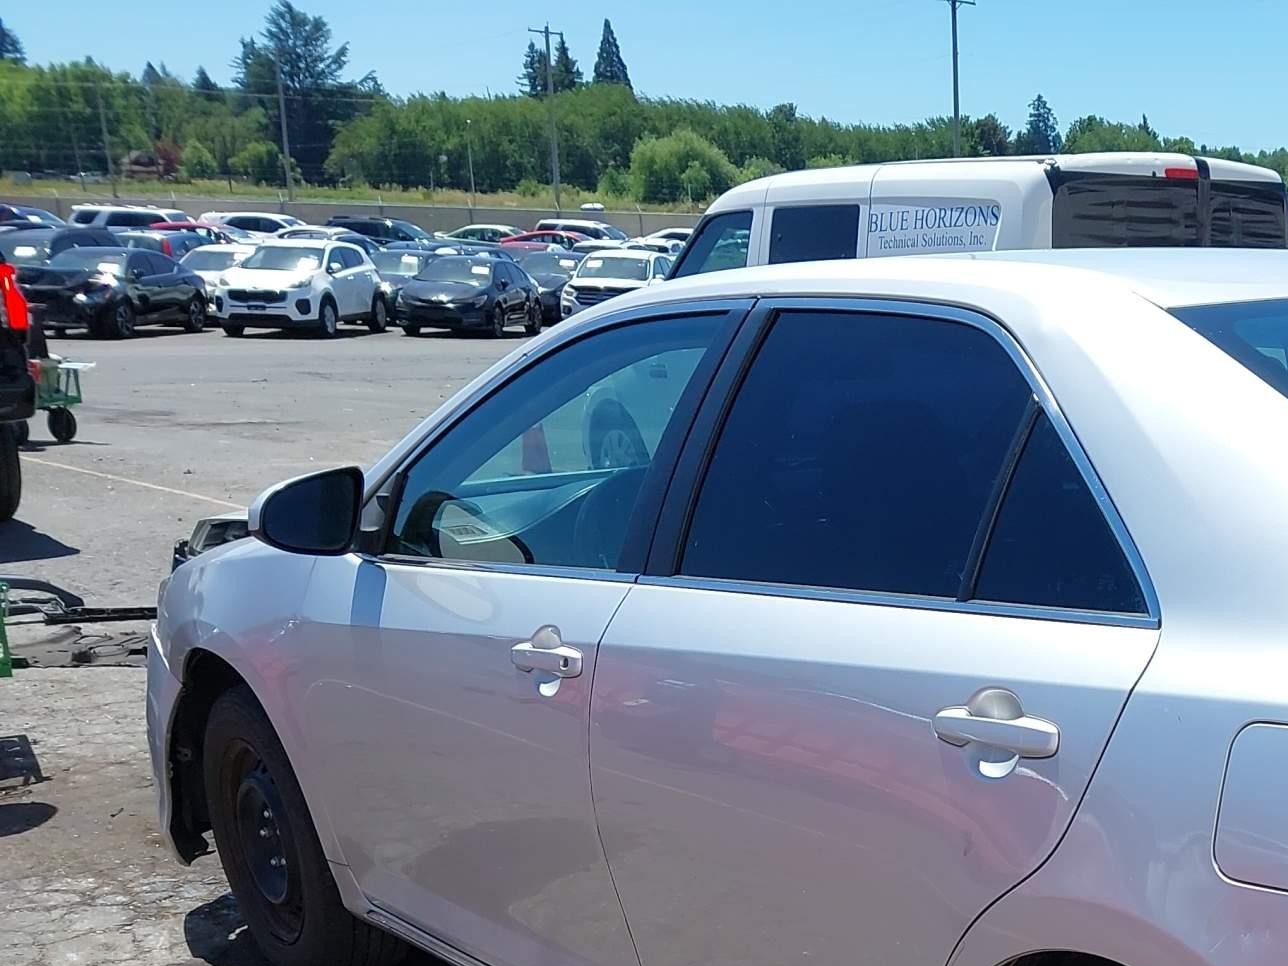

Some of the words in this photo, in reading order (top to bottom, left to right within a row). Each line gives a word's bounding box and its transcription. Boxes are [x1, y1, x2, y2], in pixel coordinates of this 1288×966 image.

[869, 210, 910, 233] BLUE
[913, 205, 1000, 229] HORIZONS
[878, 233, 919, 250] Technical
[921, 231, 966, 249] Solutions,
[968, 231, 988, 246] Inc.
